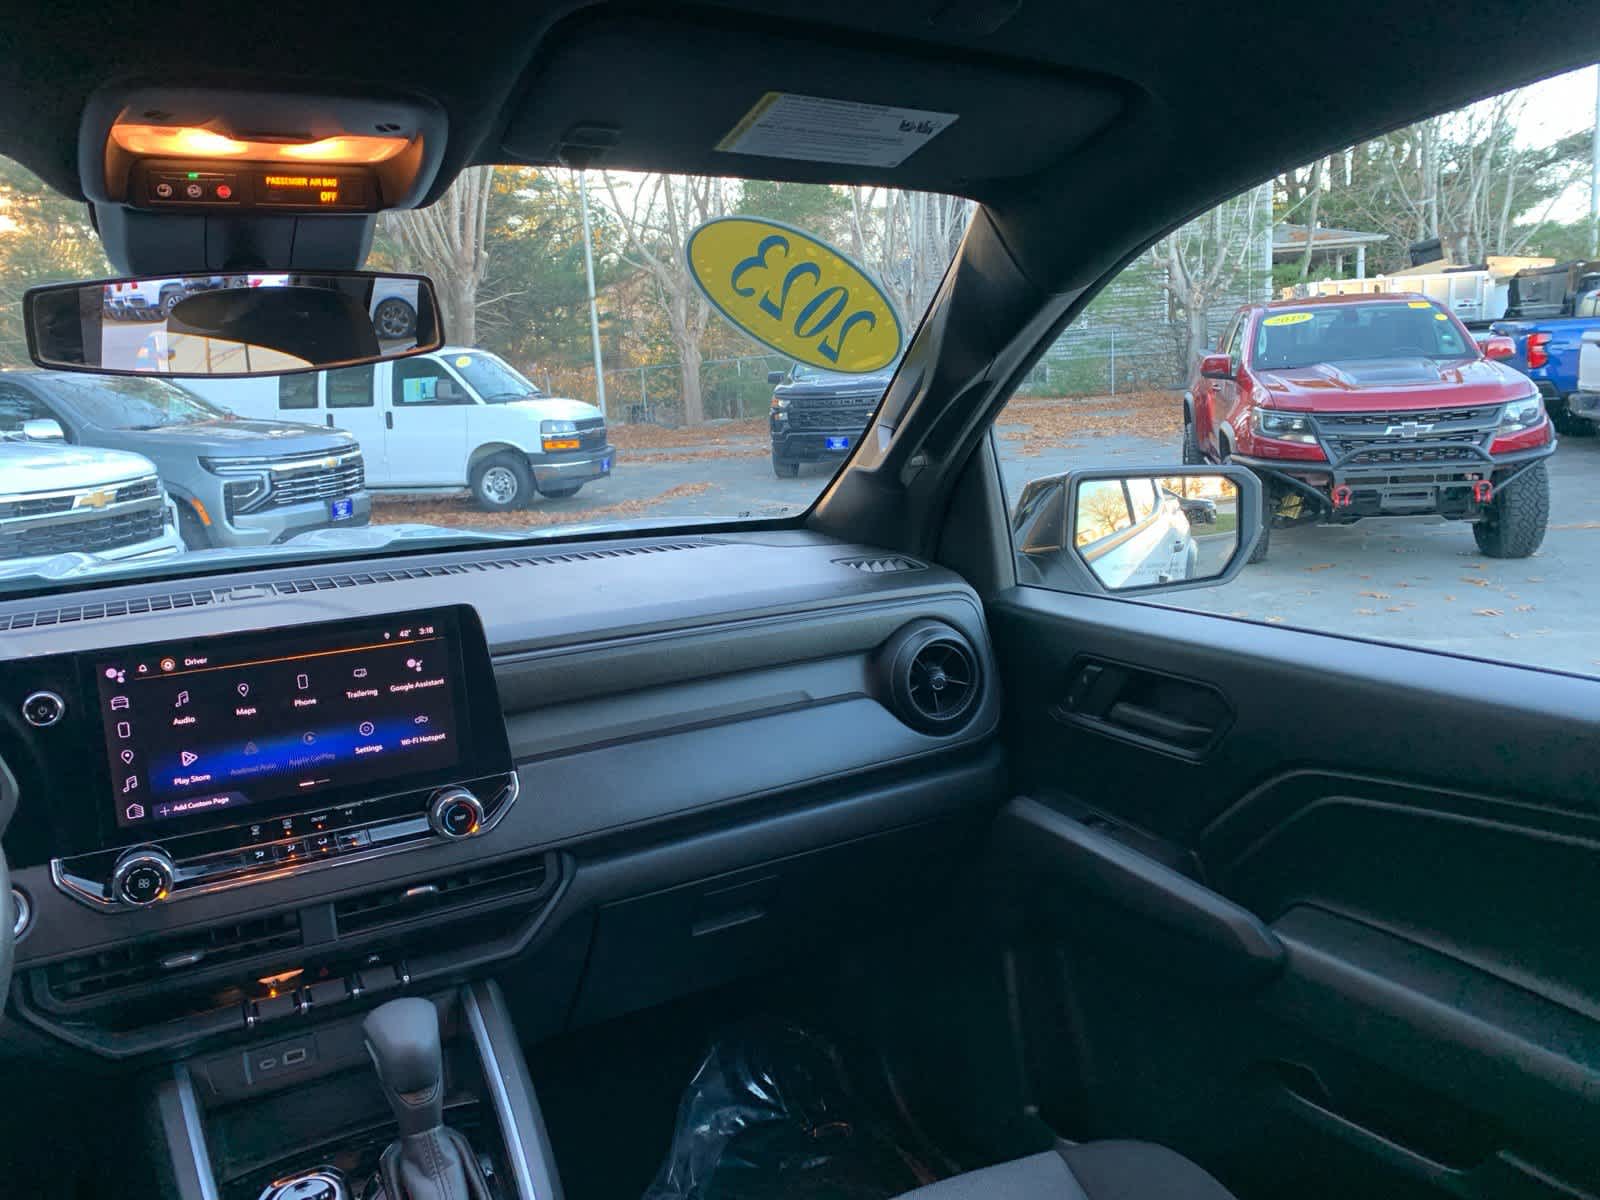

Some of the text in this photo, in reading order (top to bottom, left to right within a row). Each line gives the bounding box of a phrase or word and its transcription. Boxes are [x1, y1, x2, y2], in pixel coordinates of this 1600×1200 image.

[320, 191, 337, 202] OFF
[184, 656, 207, 666] Driver
[390, 678, 445, 694] Google Assistant
[346, 688, 379, 700] Trailering
[294, 698, 317, 708] Phone
[235, 706, 257, 717] Maps
[173, 716, 196, 727] Audio
[419, 732, 446, 745] Hotspot
[354, 743, 383, 755] Settings
[174, 773, 211, 787] Play Store
[173, 796, 230, 812] Add Custom Page
